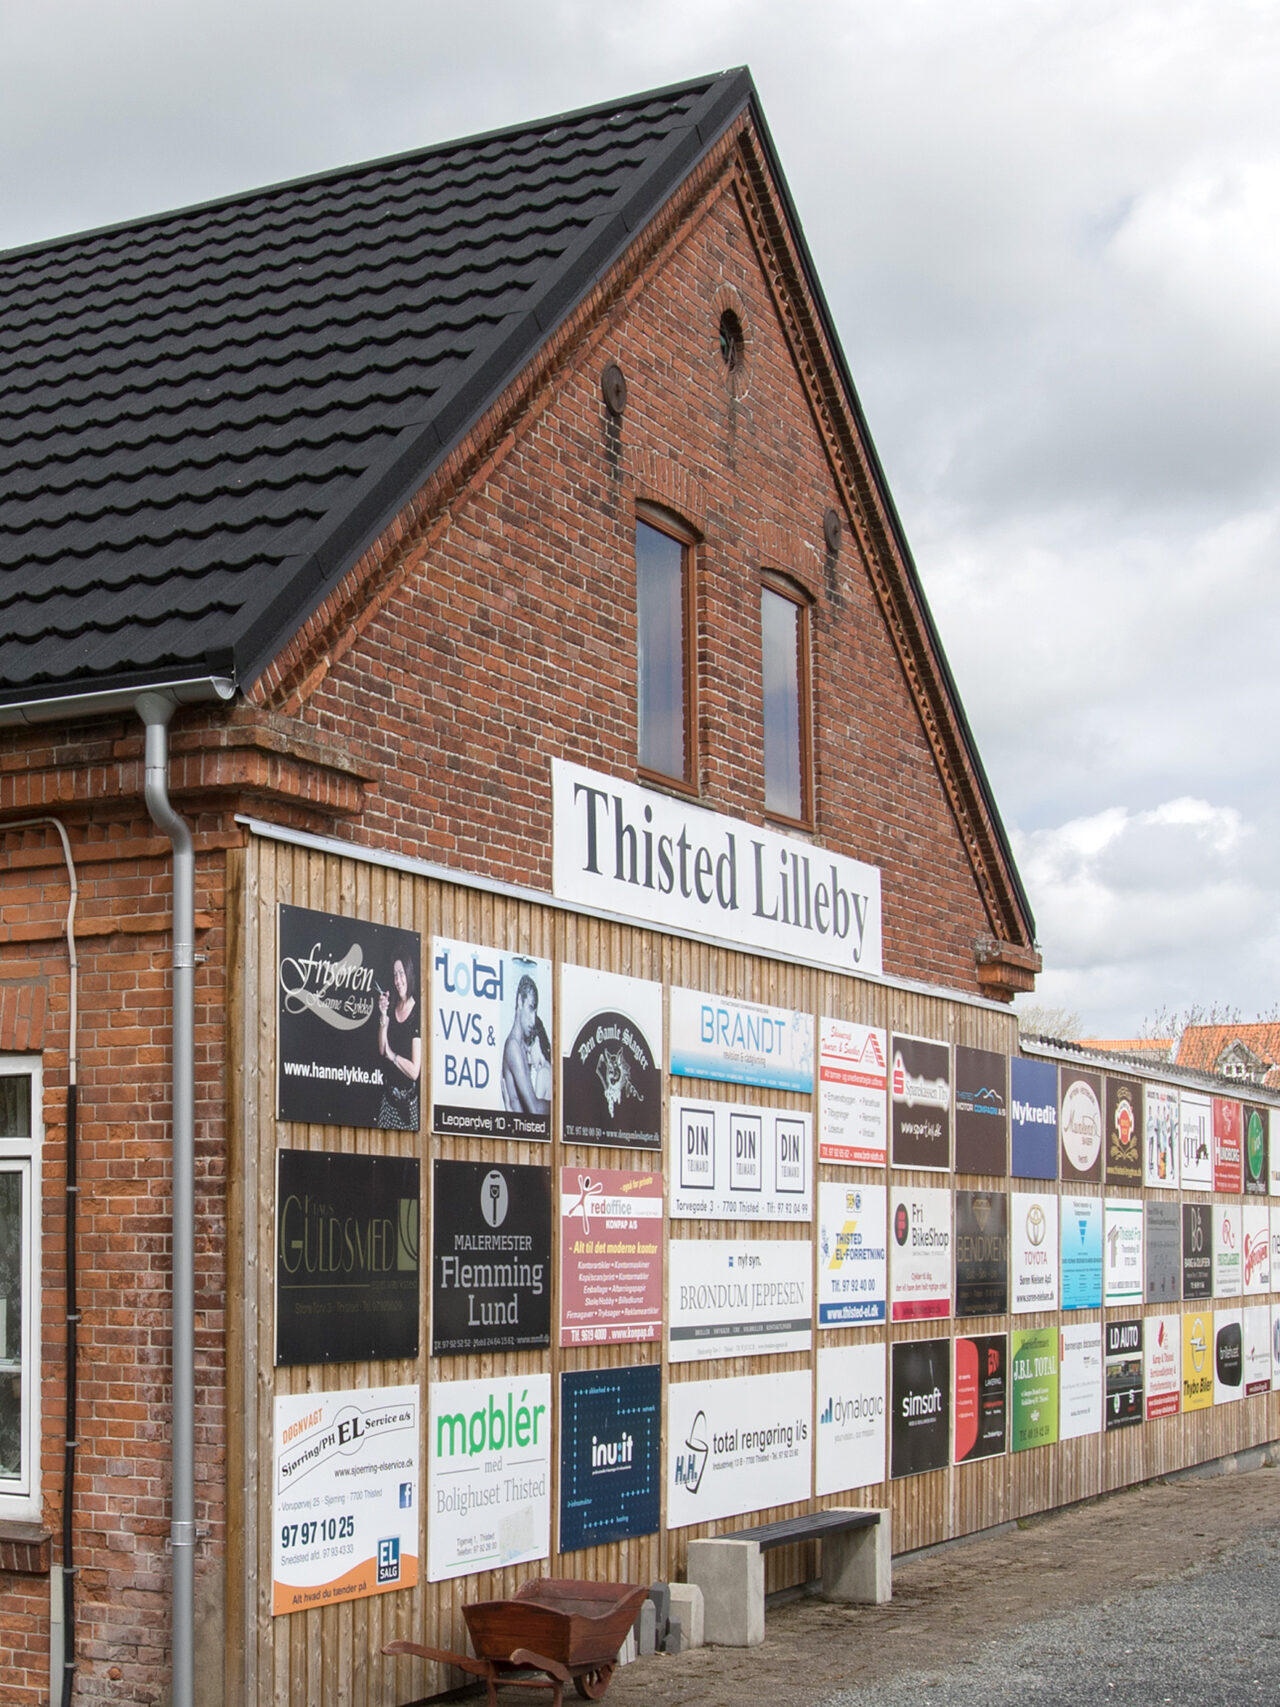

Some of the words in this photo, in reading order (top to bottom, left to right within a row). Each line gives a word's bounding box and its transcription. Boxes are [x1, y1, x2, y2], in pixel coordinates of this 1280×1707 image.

[573, 782, 739, 910] Thisted
[750, 840, 869, 963] Lilleby
[280, 942, 374, 995] Frisøren
[435, 951, 504, 1001] total
[305, 990, 341, 1011] Hanne
[343, 994, 372, 1019] Lykke
[439, 1007, 482, 1046] VVS
[487, 1025, 496, 1046] &
[701, 1005, 786, 1055] BRANDT
[578, 1037, 596, 1065] Den
[595, 1024, 620, 1044] Gamle
[621, 1028, 649, 1071] Slagter
[284, 1061, 384, 1085] www.hannelykke.dk
[444, 1054, 490, 1089] BAD
[442, 1112, 493, 1131] Leopardvej
[494, 1116, 506, 1130] 10
[513, 1119, 546, 1133] Thisted
[1012, 1100, 1056, 1126] Nykredit
[687, 1125, 709, 1156] DIN
[736, 1129, 756, 1159] DIN
[781, 1133, 800, 1162] DIN
[591, 1200, 632, 1215] redoffice
[676, 1199, 708, 1214] Torvegade
[709, 1200, 714, 1212] 3
[722, 1201, 737, 1213] 7700
[739, 1201, 760, 1213] Thisted
[777, 1202, 784, 1213] 97
[912, 1203, 924, 1223] Fri
[281, 1195, 395, 1274] GULDSMED
[606, 1220, 628, 1230] KONPAP
[629, 1221, 638, 1230] A/S
[454, 1234, 533, 1251] MALERMESTER
[573, 1240, 585, 1254] Alt
[585, 1240, 594, 1254] til
[594, 1241, 606, 1254] det
[606, 1242, 636, 1254] moderne
[637, 1242, 658, 1255] kontor
[835, 1233, 863, 1245] THISTED
[912, 1227, 949, 1251] BikeShop
[957, 1236, 1007, 1262] BENDIXEN
[737, 1253, 748, 1269] nyt
[749, 1255, 762, 1269] syn.
[835, 1248, 885, 1261] EL-FORRETNING
[1024, 1251, 1048, 1265] TOYOTA
[440, 1255, 544, 1295] Flemming
[842, 1279, 850, 1292] 97
[851, 1279, 859, 1292] 92
[860, 1279, 868, 1291] 40
[868, 1278, 876, 1291] 00
[1031, 1274, 1045, 1284] Nielsen
[680, 1283, 748, 1311] BRØNDUM
[751, 1281, 805, 1311] JEPPESEN
[468, 1293, 519, 1326] Lund
[826, 1304, 879, 1320] www.thisted-el.dk
[571, 1329, 580, 1342] Tlf.
[611, 1325, 655, 1341] www.konpap.dk
[1110, 1327, 1120, 1350] LD
[1120, 1326, 1139, 1348] AUTO
[1035, 1356, 1056, 1377] TOTAL
[1183, 1380, 1199, 1399] Thybo
[1200, 1377, 1212, 1393] Biler
[834, 1393, 884, 1428] dynalogic
[902, 1387, 942, 1418] simsoft
[282, 1408, 323, 1445] DØGNVAGT
[437, 1389, 546, 1458] møblér
[281, 1433, 336, 1477] Sjørring/PH
[337, 1416, 365, 1447] EL
[365, 1414, 398, 1429] Service
[398, 1411, 412, 1422] a/s
[592, 1431, 633, 1468] inu:it
[713, 1428, 739, 1455] total
[741, 1422, 793, 1453] rengøring
[795, 1419, 808, 1441] i/s
[334, 1457, 414, 1478] www.sjoerring-elservice.dk
[484, 1456, 503, 1474] med
[674, 1454, 698, 1483] H.H.
[324, 1492, 346, 1507] Sjørring
[350, 1490, 364, 1502] 7700
[364, 1488, 383, 1499] Thisted
[436, 1481, 501, 1517] Bolighuset
[504, 1473, 546, 1502] Thisted
[281, 1524, 299, 1549] 97
[300, 1521, 318, 1546] 97
[320, 1518, 337, 1542] 10
[338, 1515, 355, 1538] 25
[280, 1552, 309, 1567] Snedsted
[322, 1548, 331, 1559] 97
[331, 1547, 338, 1557] 93
[339, 1545, 346, 1556] 43
[380, 1542, 398, 1568] EL
[379, 1566, 398, 1580] SALG
[292, 1594, 302, 1606] Alt
[303, 1590, 320, 1603] hvad
[321, 1589, 332, 1600] du
[332, 1585, 357, 1598] tænder
[358, 1581, 367, 1595] på
